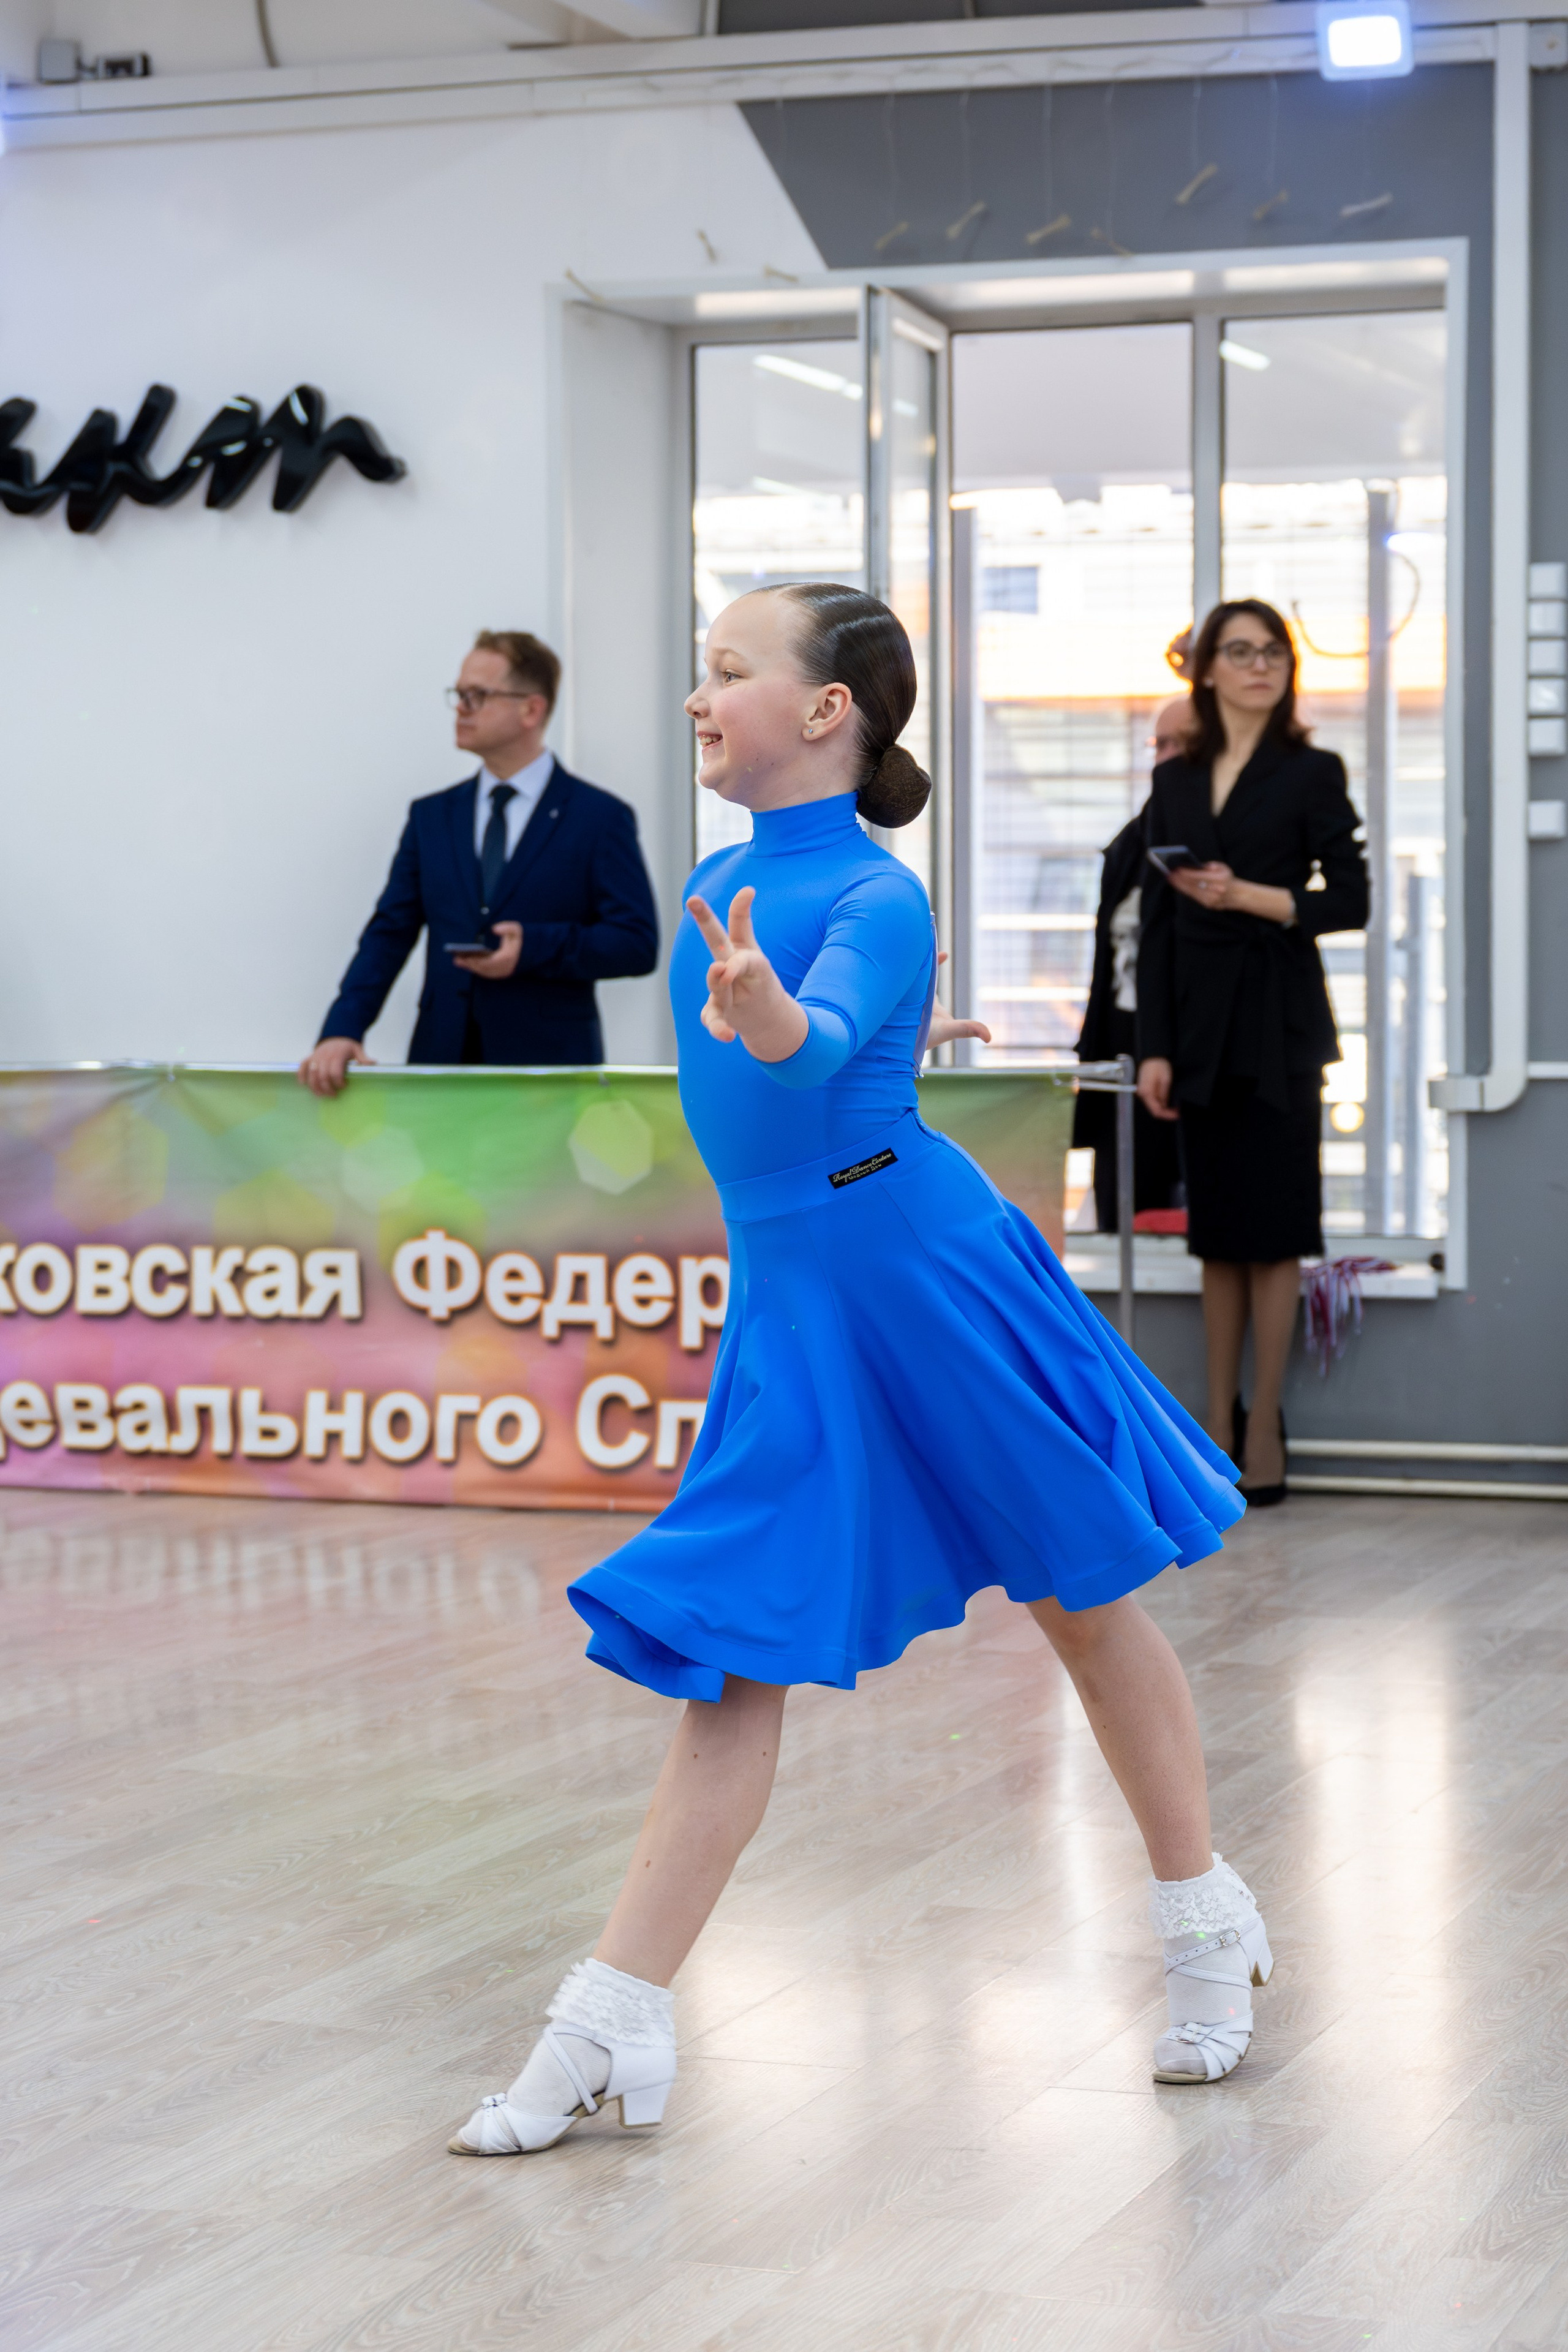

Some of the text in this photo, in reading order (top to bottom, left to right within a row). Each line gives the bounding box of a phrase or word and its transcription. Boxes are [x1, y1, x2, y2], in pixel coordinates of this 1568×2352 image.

[833, 1169, 852, 1183] Royal
[851, 1164, 872, 1175] Dance
[0, 1242, 363, 1319] овская
[0, 1379, 544, 1466] евального
